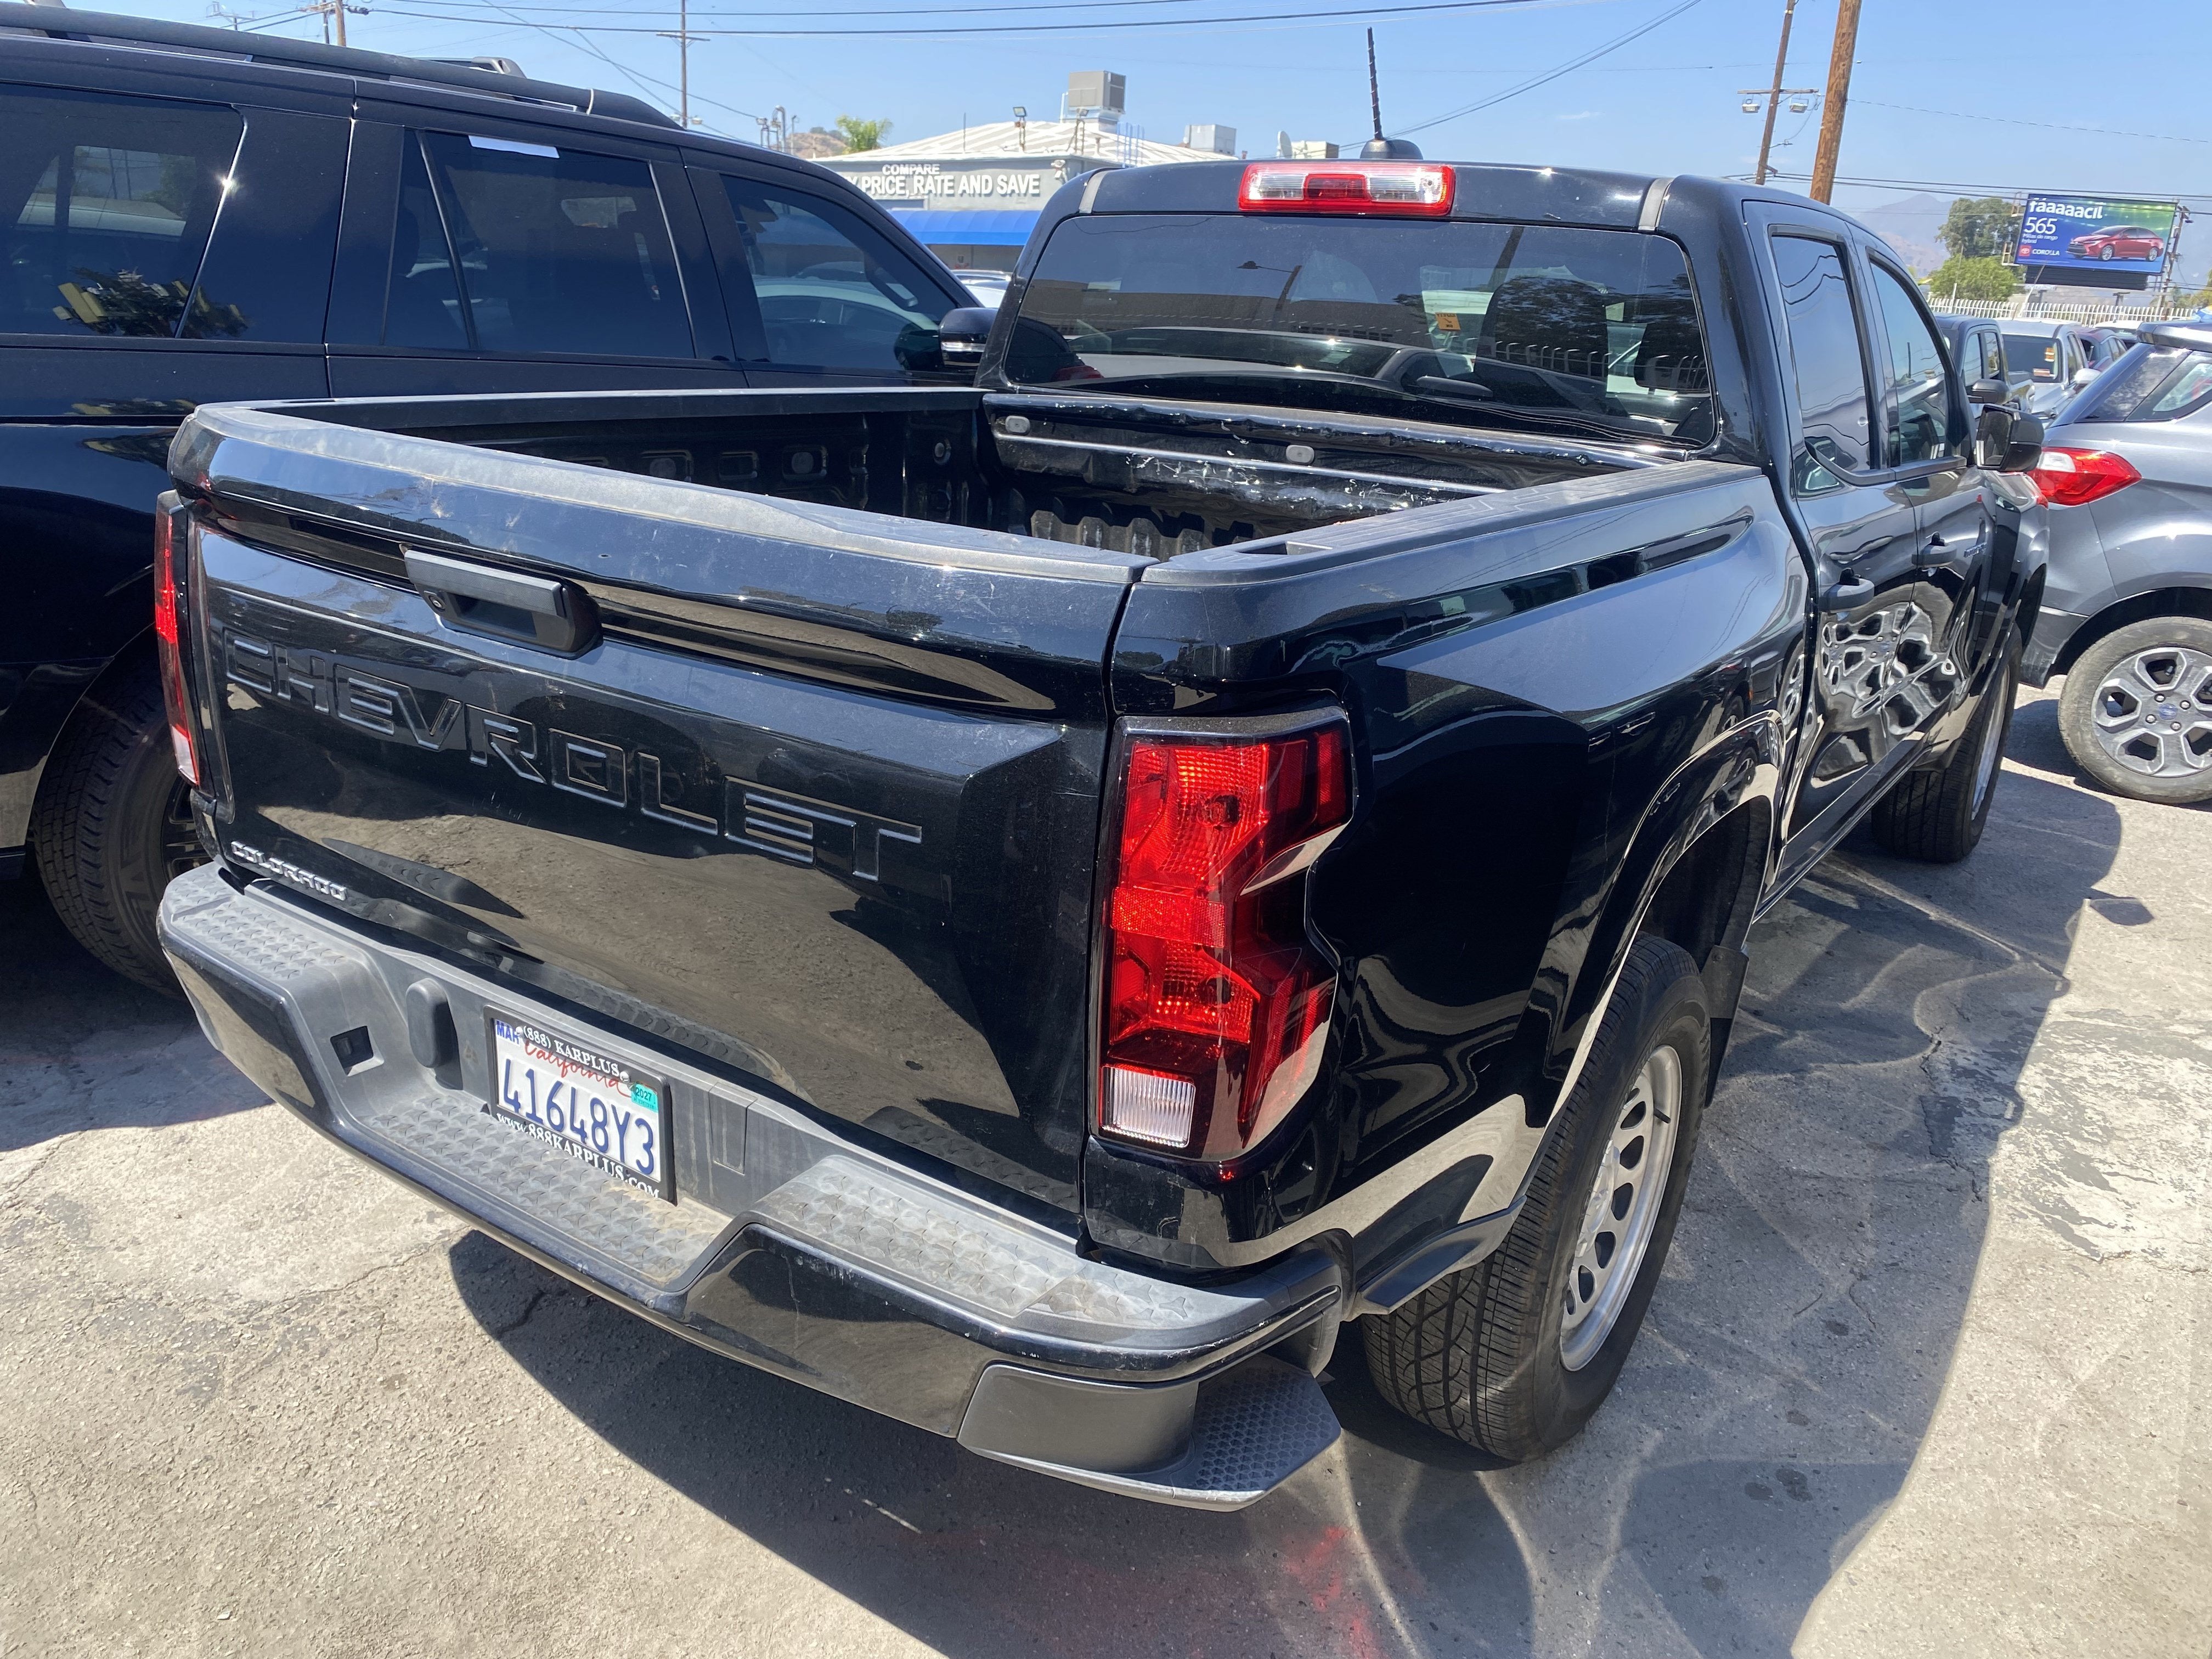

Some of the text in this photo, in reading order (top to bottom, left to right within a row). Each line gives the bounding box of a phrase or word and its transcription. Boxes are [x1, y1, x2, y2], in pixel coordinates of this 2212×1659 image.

[861, 176, 910, 197] PRICE,
[914, 175, 954, 195] RATE
[957, 174, 992, 195] AND
[997, 174, 1040, 195] SAVE
[882, 164, 940, 176] COMPARE
[2024, 217, 2057, 234] 565
[224, 628, 923, 879] CHEVROLET
[230, 840, 347, 901] COLORADO
[523, 1025, 619, 1076] (888) KARPLUS
[635, 1086, 652, 1102] 2027
[504, 1059, 653, 1175] 41648Y3
